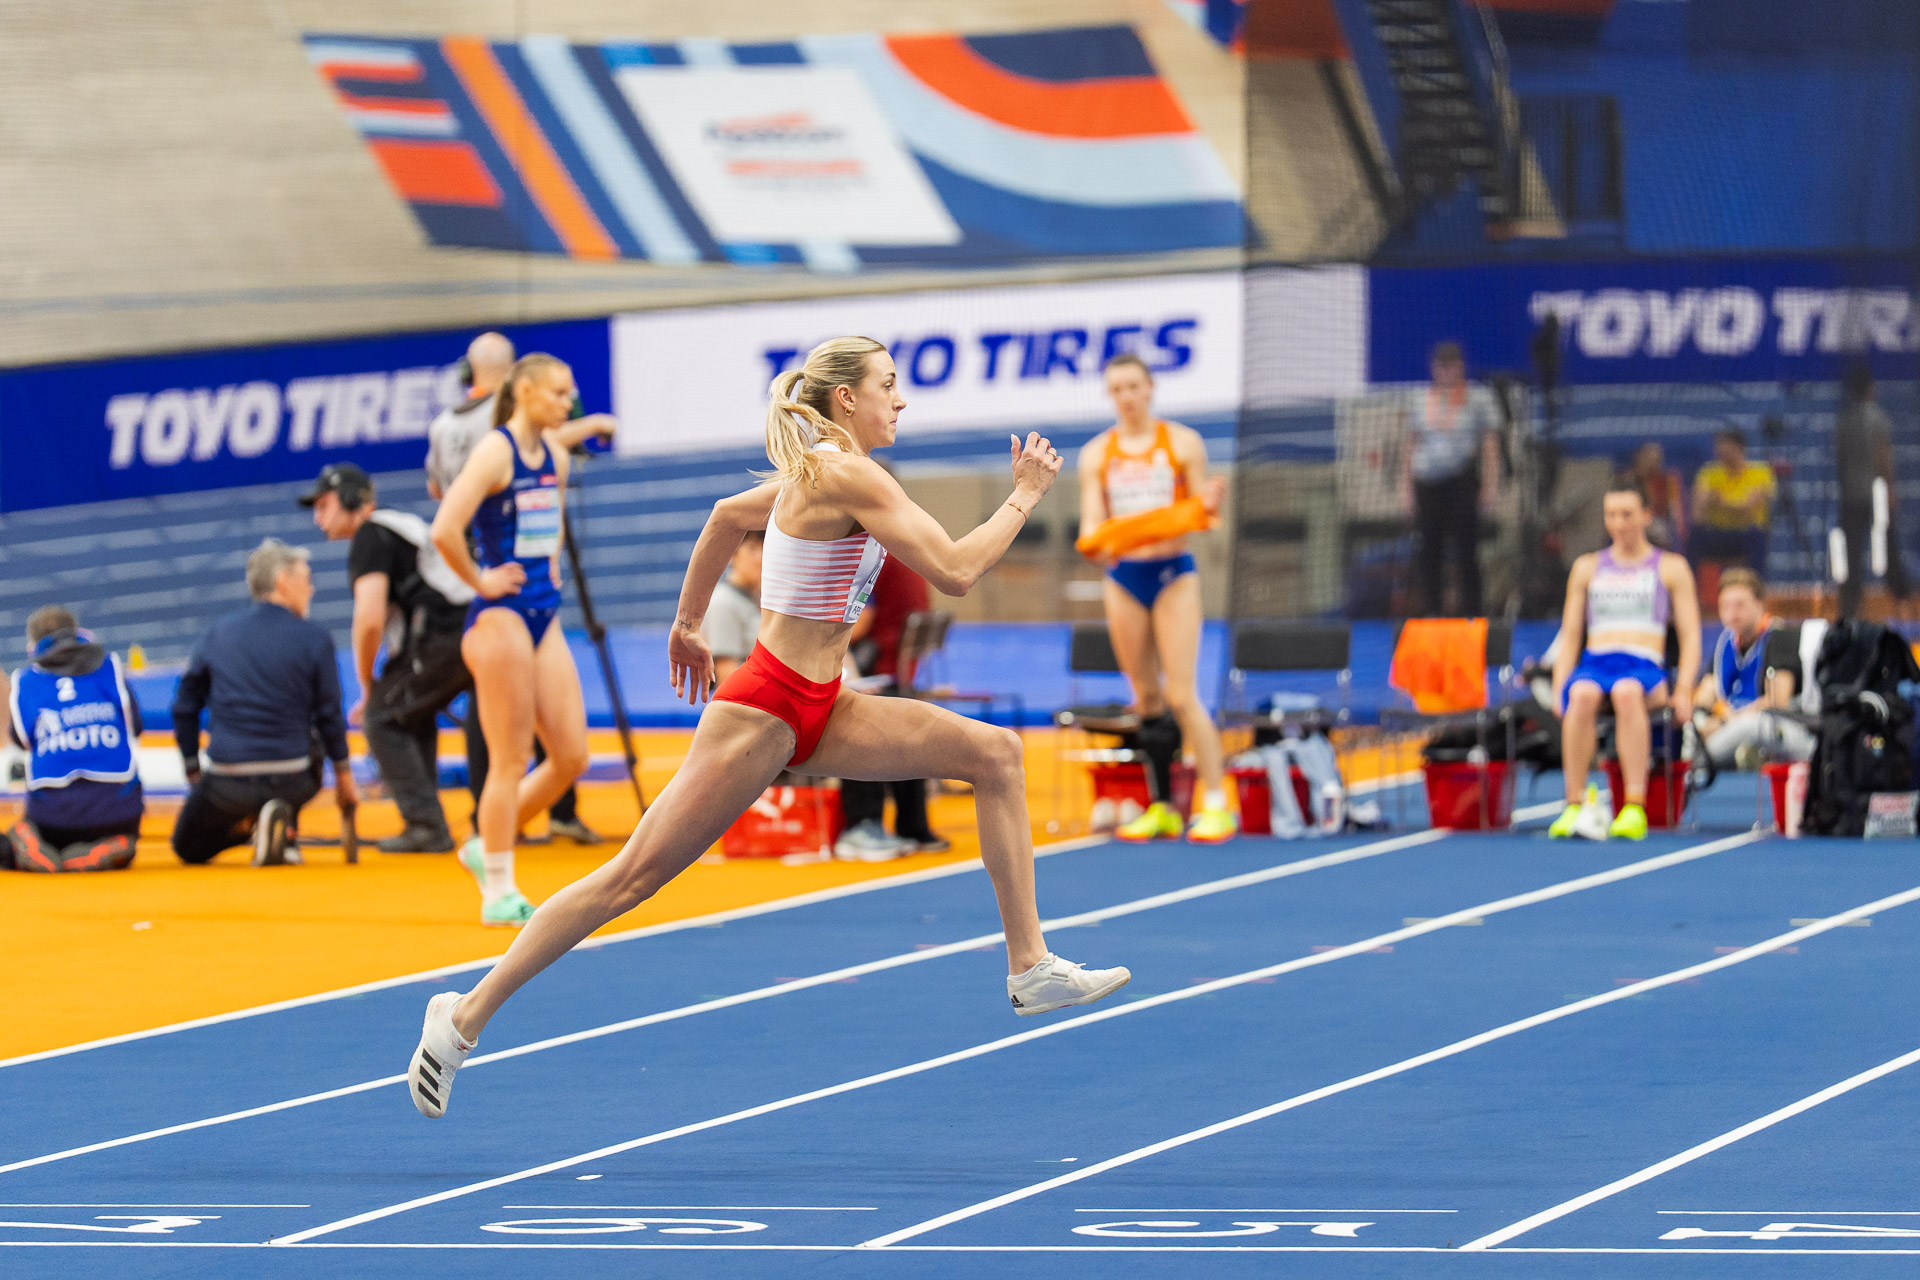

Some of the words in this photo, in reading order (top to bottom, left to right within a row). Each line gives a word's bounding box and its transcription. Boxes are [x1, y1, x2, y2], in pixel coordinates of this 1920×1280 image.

[1528, 287, 1765, 358] TOYO
[1773, 287, 1920, 356] TIR
[979, 318, 1198, 382] TIRES
[104, 380, 282, 469] TOYO
[56, 677, 77, 702] 2
[480, 1218, 769, 1234] 6
[1071, 1220, 1376, 1237] 5
[1659, 1222, 1920, 1240] 4
